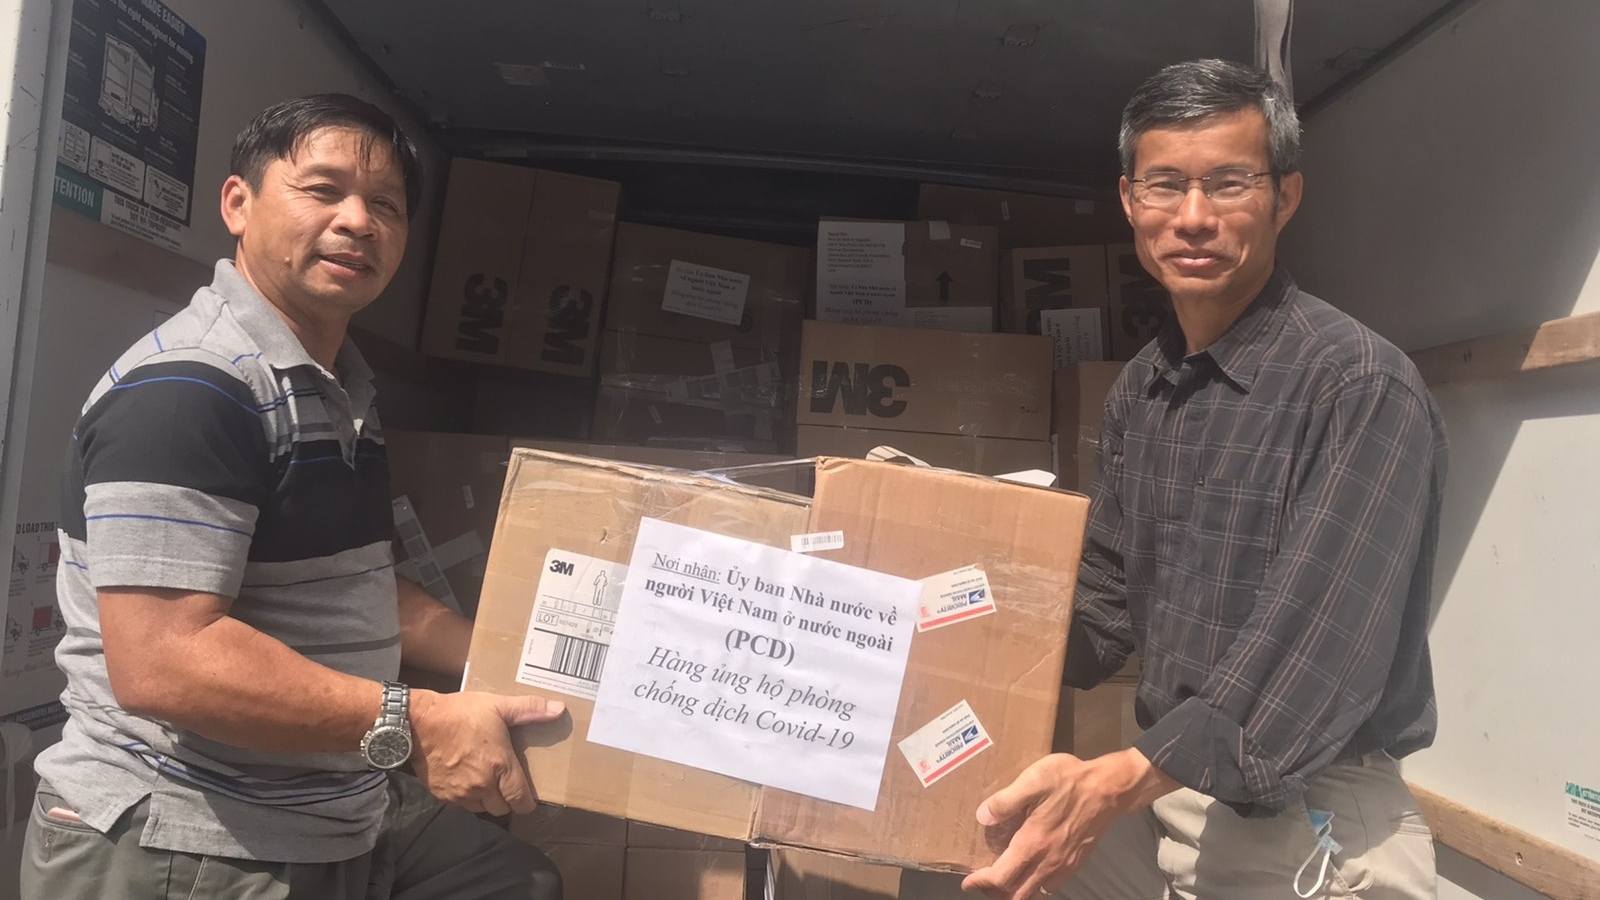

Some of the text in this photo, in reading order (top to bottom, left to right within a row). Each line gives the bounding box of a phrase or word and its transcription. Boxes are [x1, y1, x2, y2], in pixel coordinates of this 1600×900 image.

[457, 273, 508, 355] 3M
[541, 284, 593, 367] 3M
[810, 360, 911, 418] 3M
[549, 559, 575, 577] 3M
[653, 552, 898, 626] Nơi nhận: Ủy ban Nhà nước về
[951, 593, 967, 602] MAIL
[539, 611, 556, 625] LOT
[645, 578, 894, 652] người Việt Nam ở nước ngoài
[725, 628, 796, 667] (PCD)
[634, 680, 700, 716] chống
[703, 697, 750, 724] dịch
[756, 710, 855, 750] Covid-19
[646, 646, 856, 722] Hàng ủng hộ phòng
[946, 735, 961, 748] MAIL
